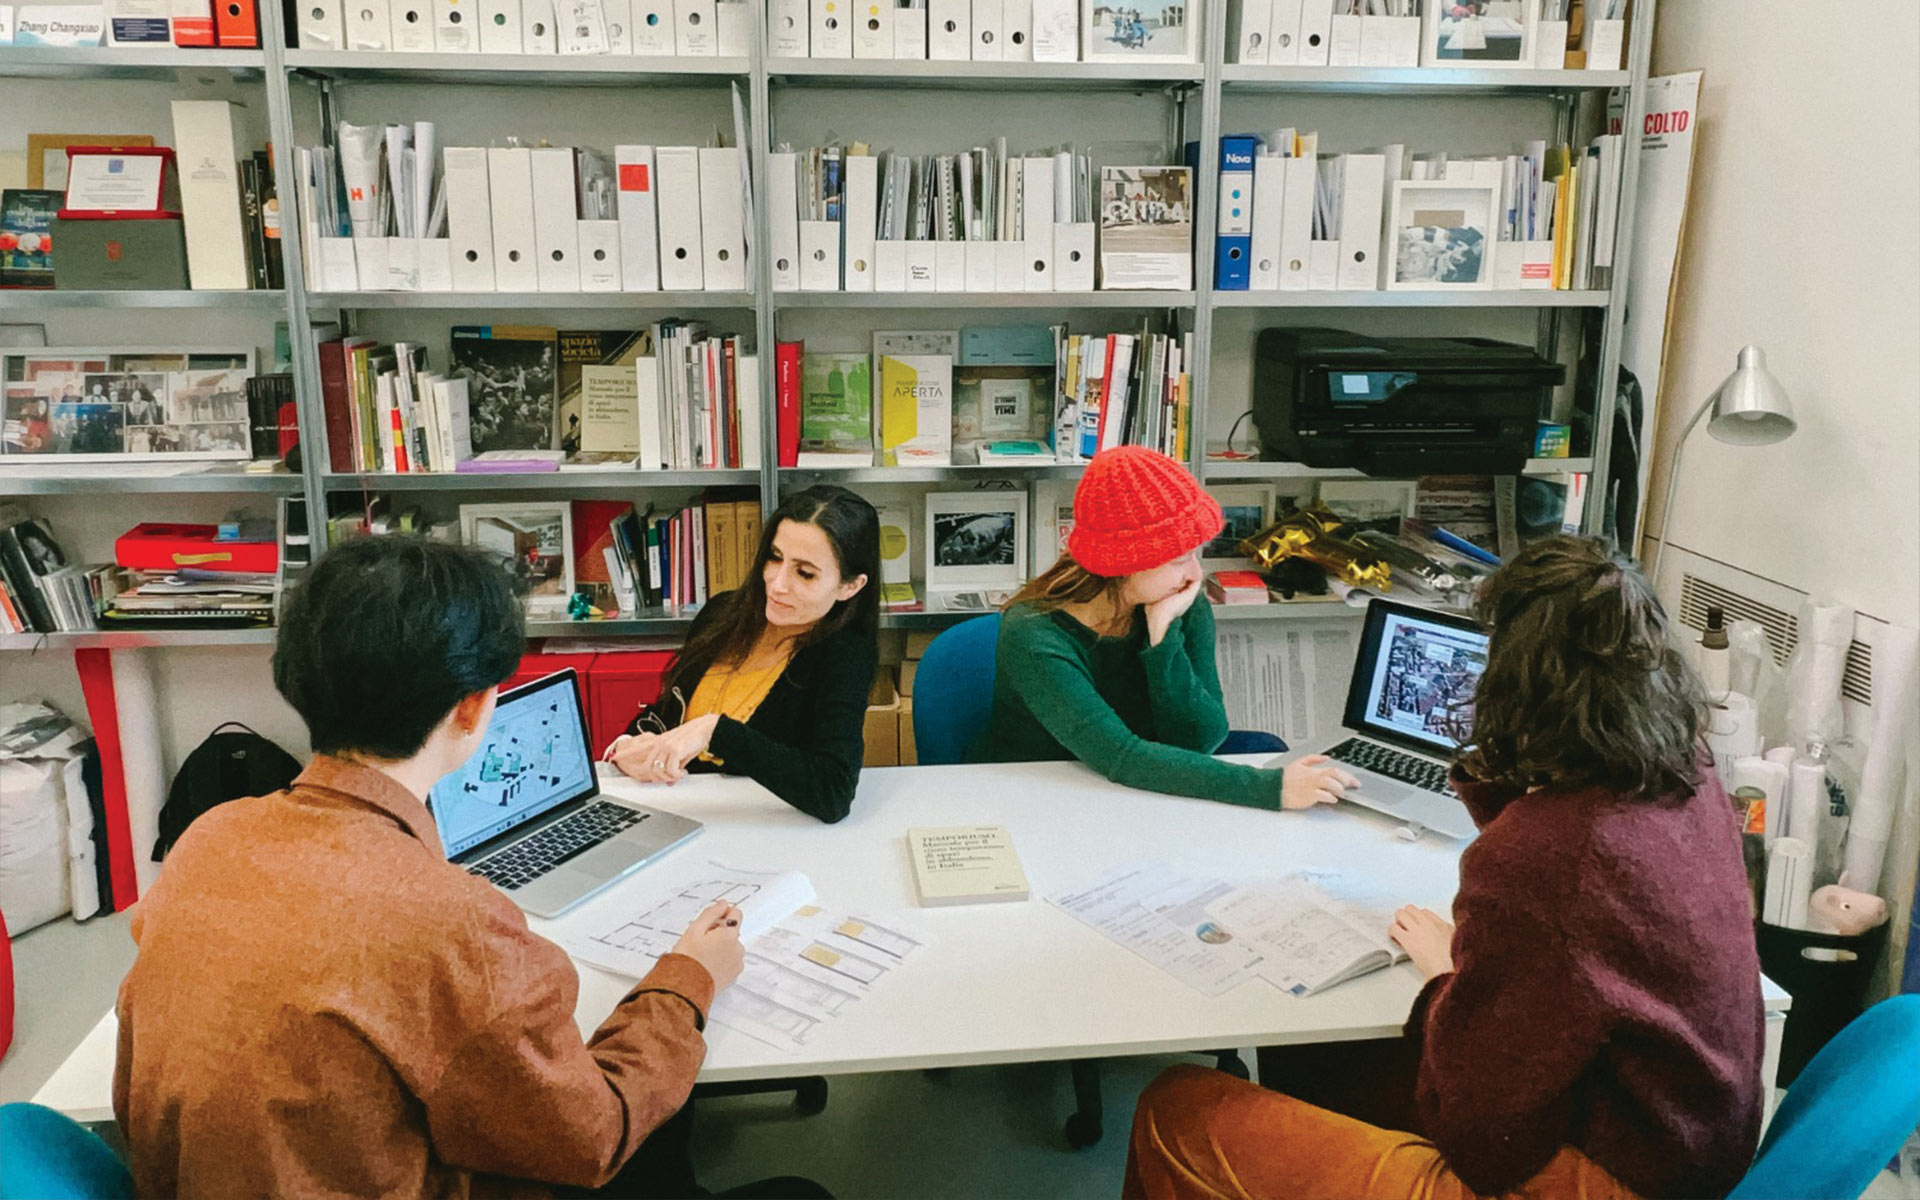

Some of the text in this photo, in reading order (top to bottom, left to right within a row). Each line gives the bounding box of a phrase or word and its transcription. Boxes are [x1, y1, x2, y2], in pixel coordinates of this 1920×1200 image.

[19, 21, 47, 34] Zhang
[50, 22, 99, 35] Changxiao
[1644, 110, 1689, 135] COLTO
[1226, 153, 1251, 164] Nova
[893, 387, 943, 398] APERTA
[994, 405, 1017, 415] TIME
